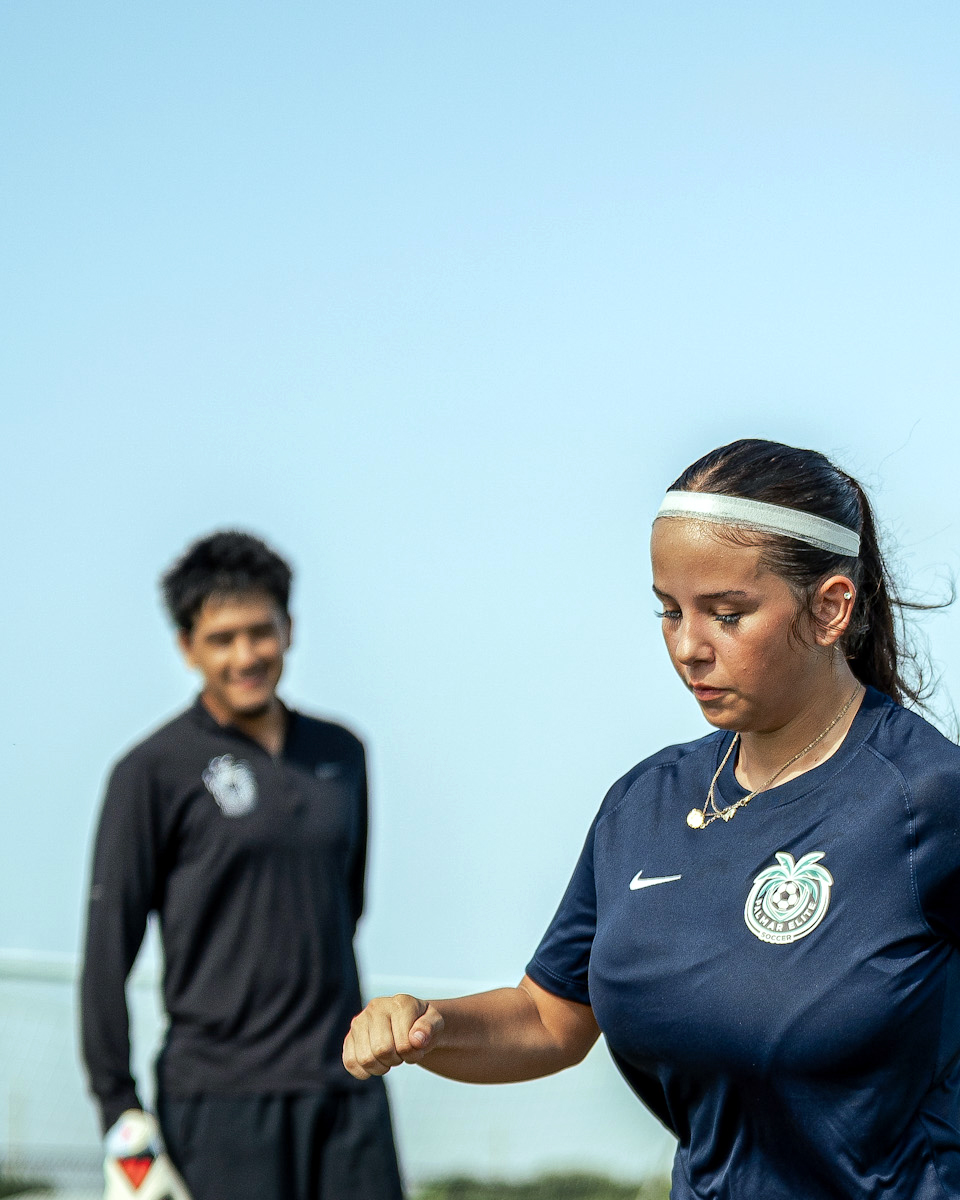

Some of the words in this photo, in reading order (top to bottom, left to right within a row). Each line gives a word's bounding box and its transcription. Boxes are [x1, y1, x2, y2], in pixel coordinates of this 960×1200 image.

[753, 897, 784, 931] PALMAR
[787, 902, 816, 930] ELITE
[760, 932, 792, 941] SOCCER
